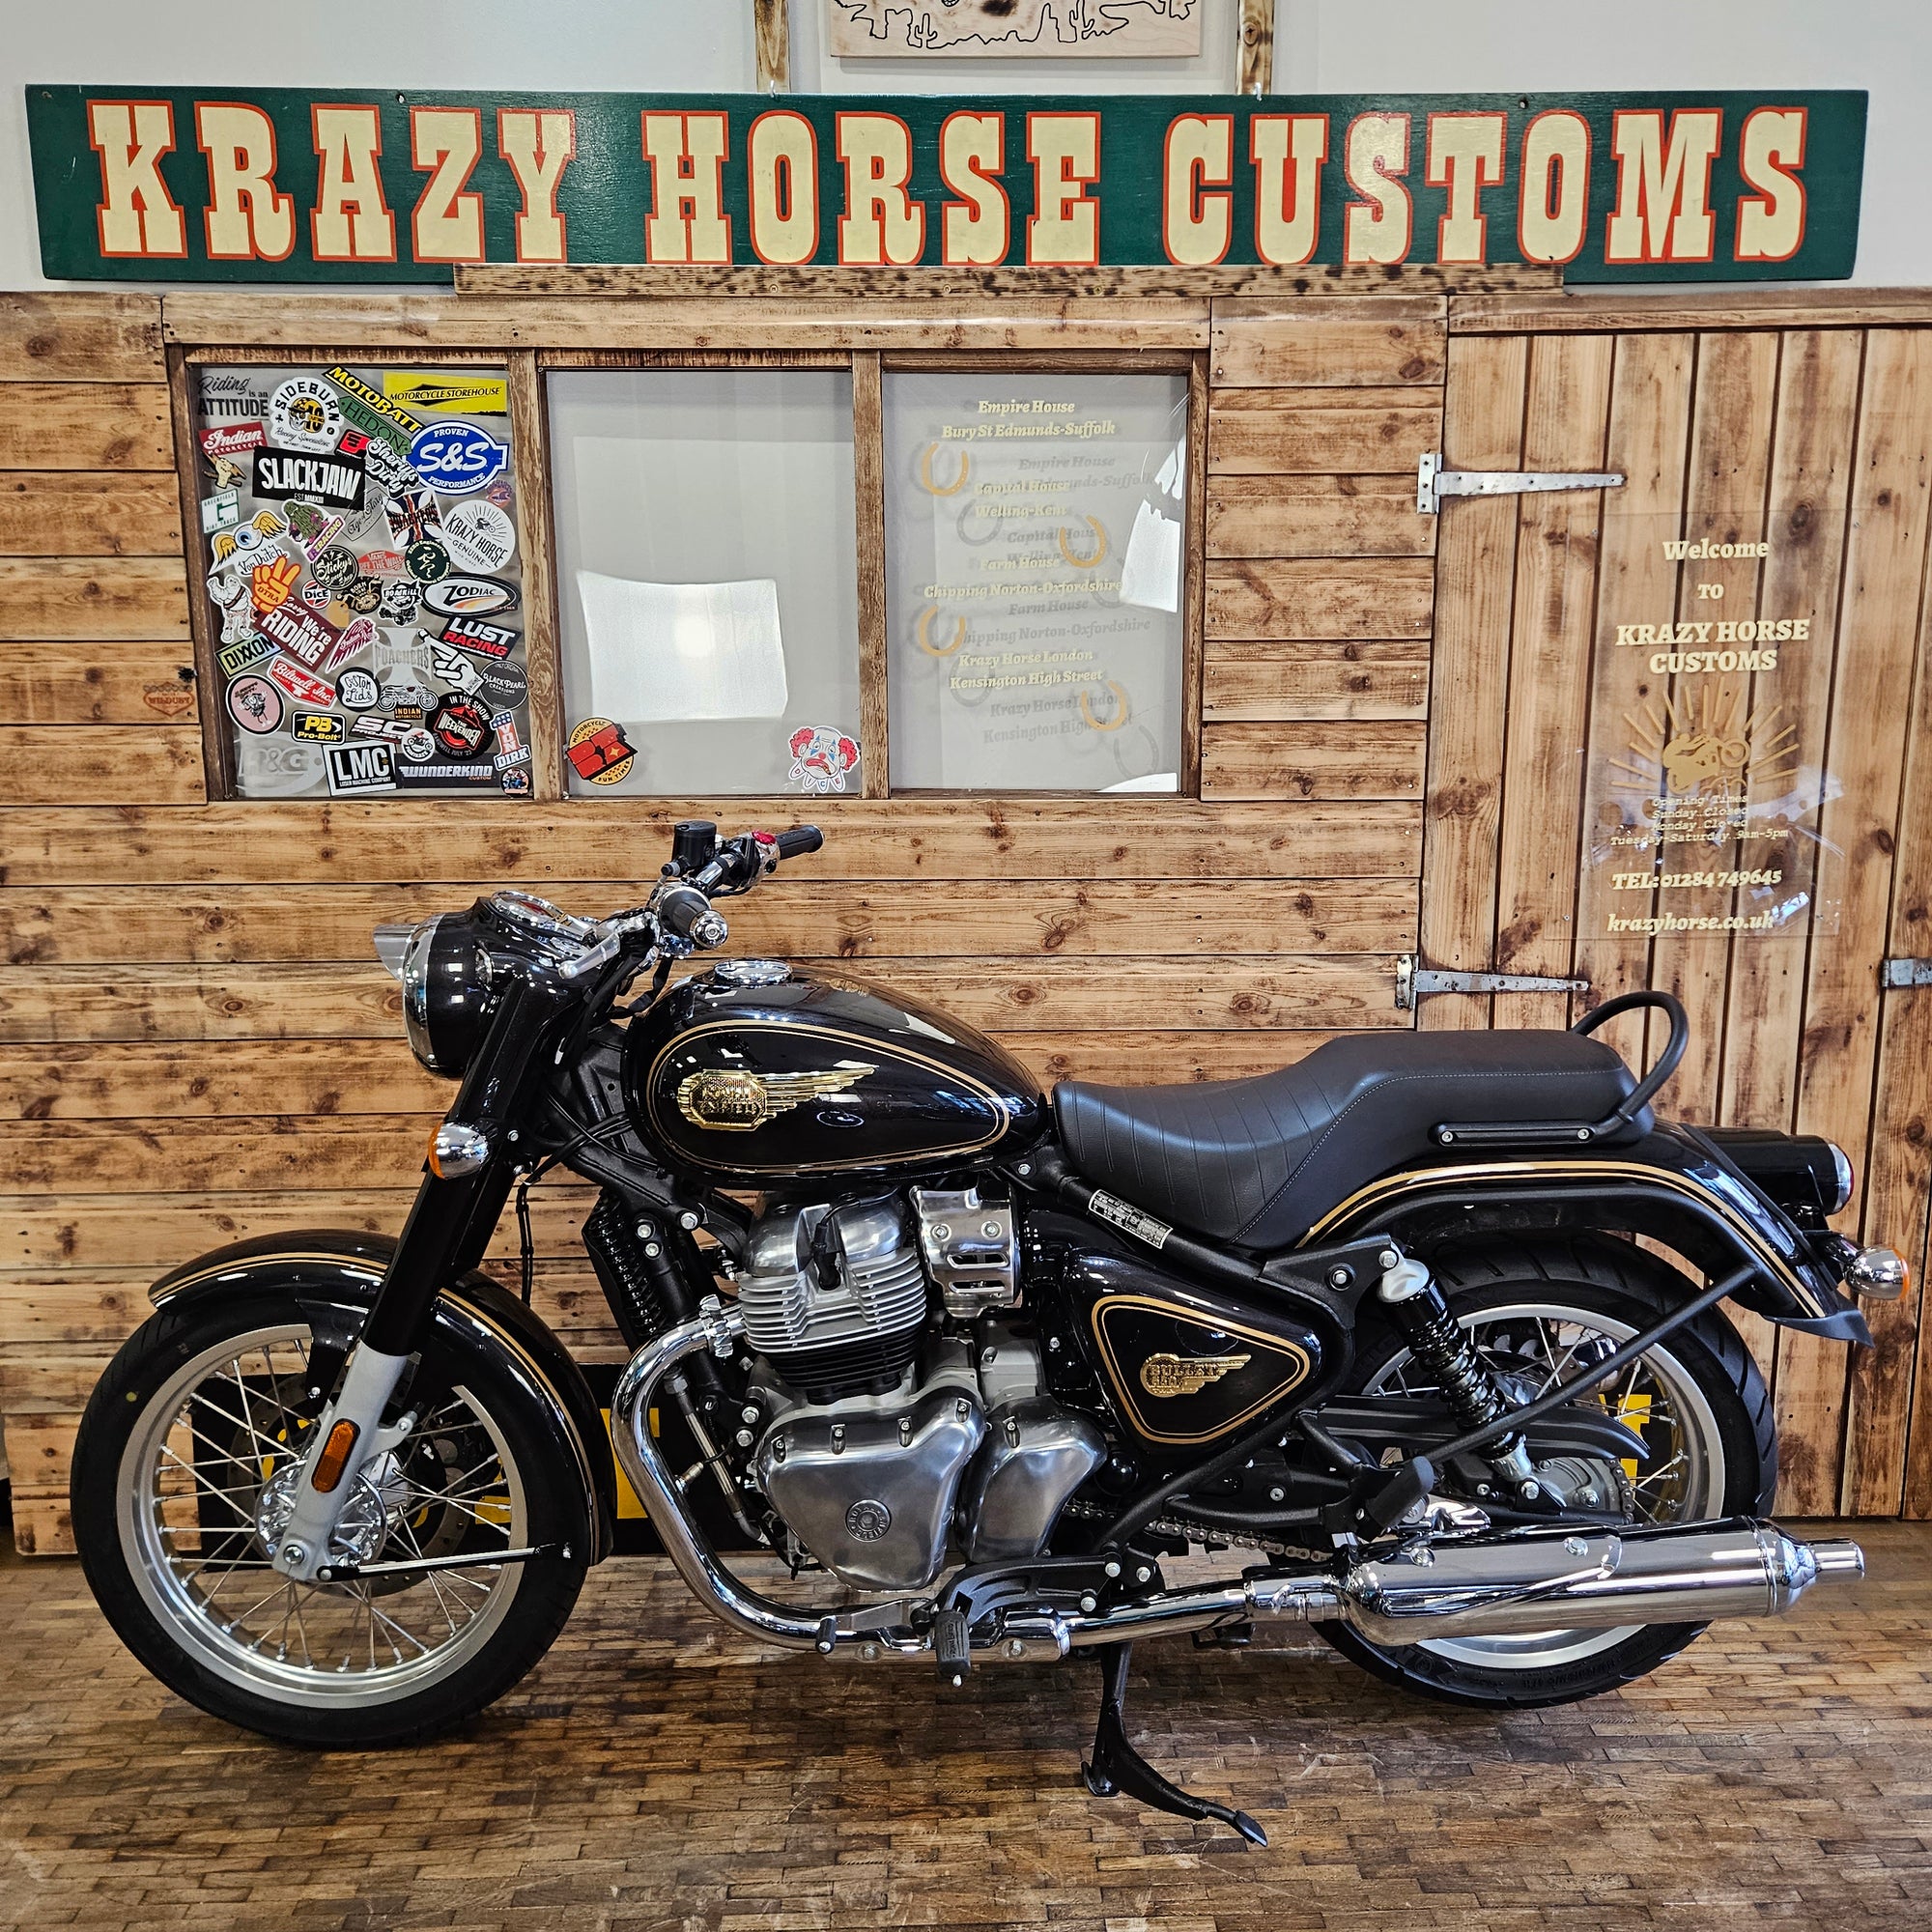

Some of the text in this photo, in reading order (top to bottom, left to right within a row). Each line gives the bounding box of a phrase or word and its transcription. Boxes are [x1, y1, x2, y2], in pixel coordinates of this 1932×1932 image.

[87, 99, 1808, 266] KRAZY HORSE CUSTOMS
[197, 375, 251, 395] Riding
[389, 386, 500, 401] MOTORCYCLE STOREHOUSE
[198, 397, 270, 416] ATTITUDE
[274, 381, 340, 422] SIDEBURN
[328, 366, 423, 433] MOTOBATT
[979, 398, 1075, 415] Empire House
[204, 429, 263, 450] Indian
[434, 428, 469, 438] PROVEN
[941, 419, 1116, 440] Bury St Edmunds-Suffolk
[417, 441, 491, 471] S&S
[258, 457, 361, 500] SLACKJAW
[428, 472, 486, 489] PERFORMANCE
[445, 513, 479, 544] KRAZY
[475, 536, 508, 568] HORSE
[1662, 537, 1770, 560] Welcome
[452, 539, 487, 566] GENUINE
[443, 585, 497, 607] ZODIAC
[923, 582, 987, 599] Chipping
[1697, 583, 1724, 599] TO
[261, 610, 326, 665] RIDING
[300, 614, 332, 645] We're
[448, 617, 515, 645] LUST
[1615, 618, 1810, 646] KRAZY HORSE
[223, 635, 276, 667] DIXXON
[442, 631, 509, 656] RACING
[958, 648, 1094, 668] Krazy Horse London
[1649, 649, 1778, 673] CUSTOMS
[950, 668, 1103, 690] Kensington High Street
[449, 696, 458, 704] IN
[459, 695, 472, 706] THE
[471, 700, 491, 721] SHOW
[303, 716, 332, 732] PB
[354, 716, 412, 734] SC
[438, 711, 482, 747] WEEKENDER
[333, 747, 390, 781] LMC
[496, 747, 531, 769] DIRK
[399, 766, 494, 778] WUNDERKIND
[1652, 798, 1705, 808] Opening
[1607, 910, 1775, 936] krazyhorse.co.uk
